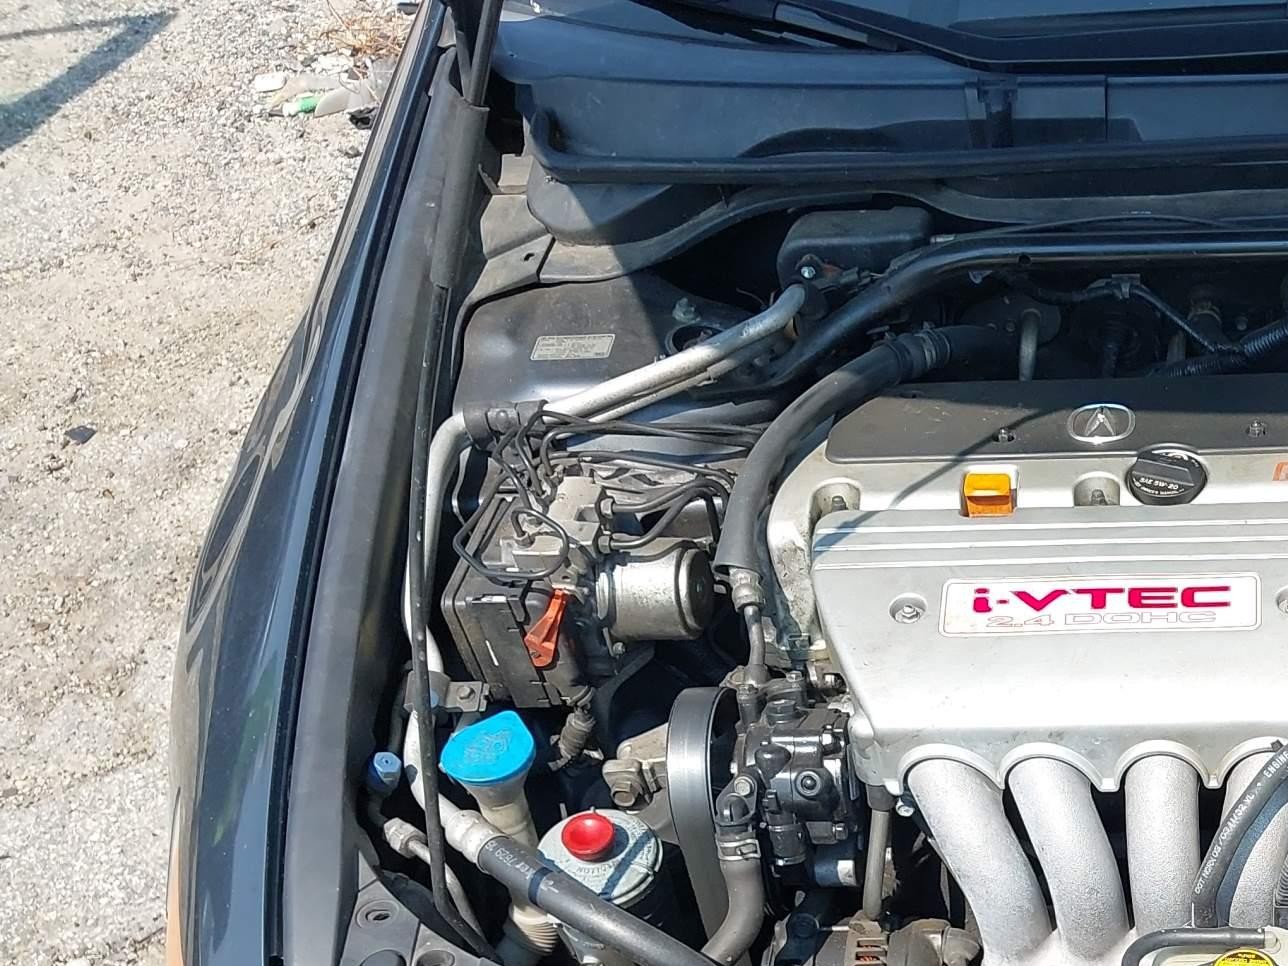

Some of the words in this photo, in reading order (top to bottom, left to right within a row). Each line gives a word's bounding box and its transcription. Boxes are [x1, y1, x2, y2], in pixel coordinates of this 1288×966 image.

[1139, 477, 1153, 485] SAE
[1153, 480, 1179, 490] 5W-20
[973, 585, 1231, 613] i-VTEC
[986, 613, 1055, 628] 2.4
[1064, 611, 1217, 626] DOHC
